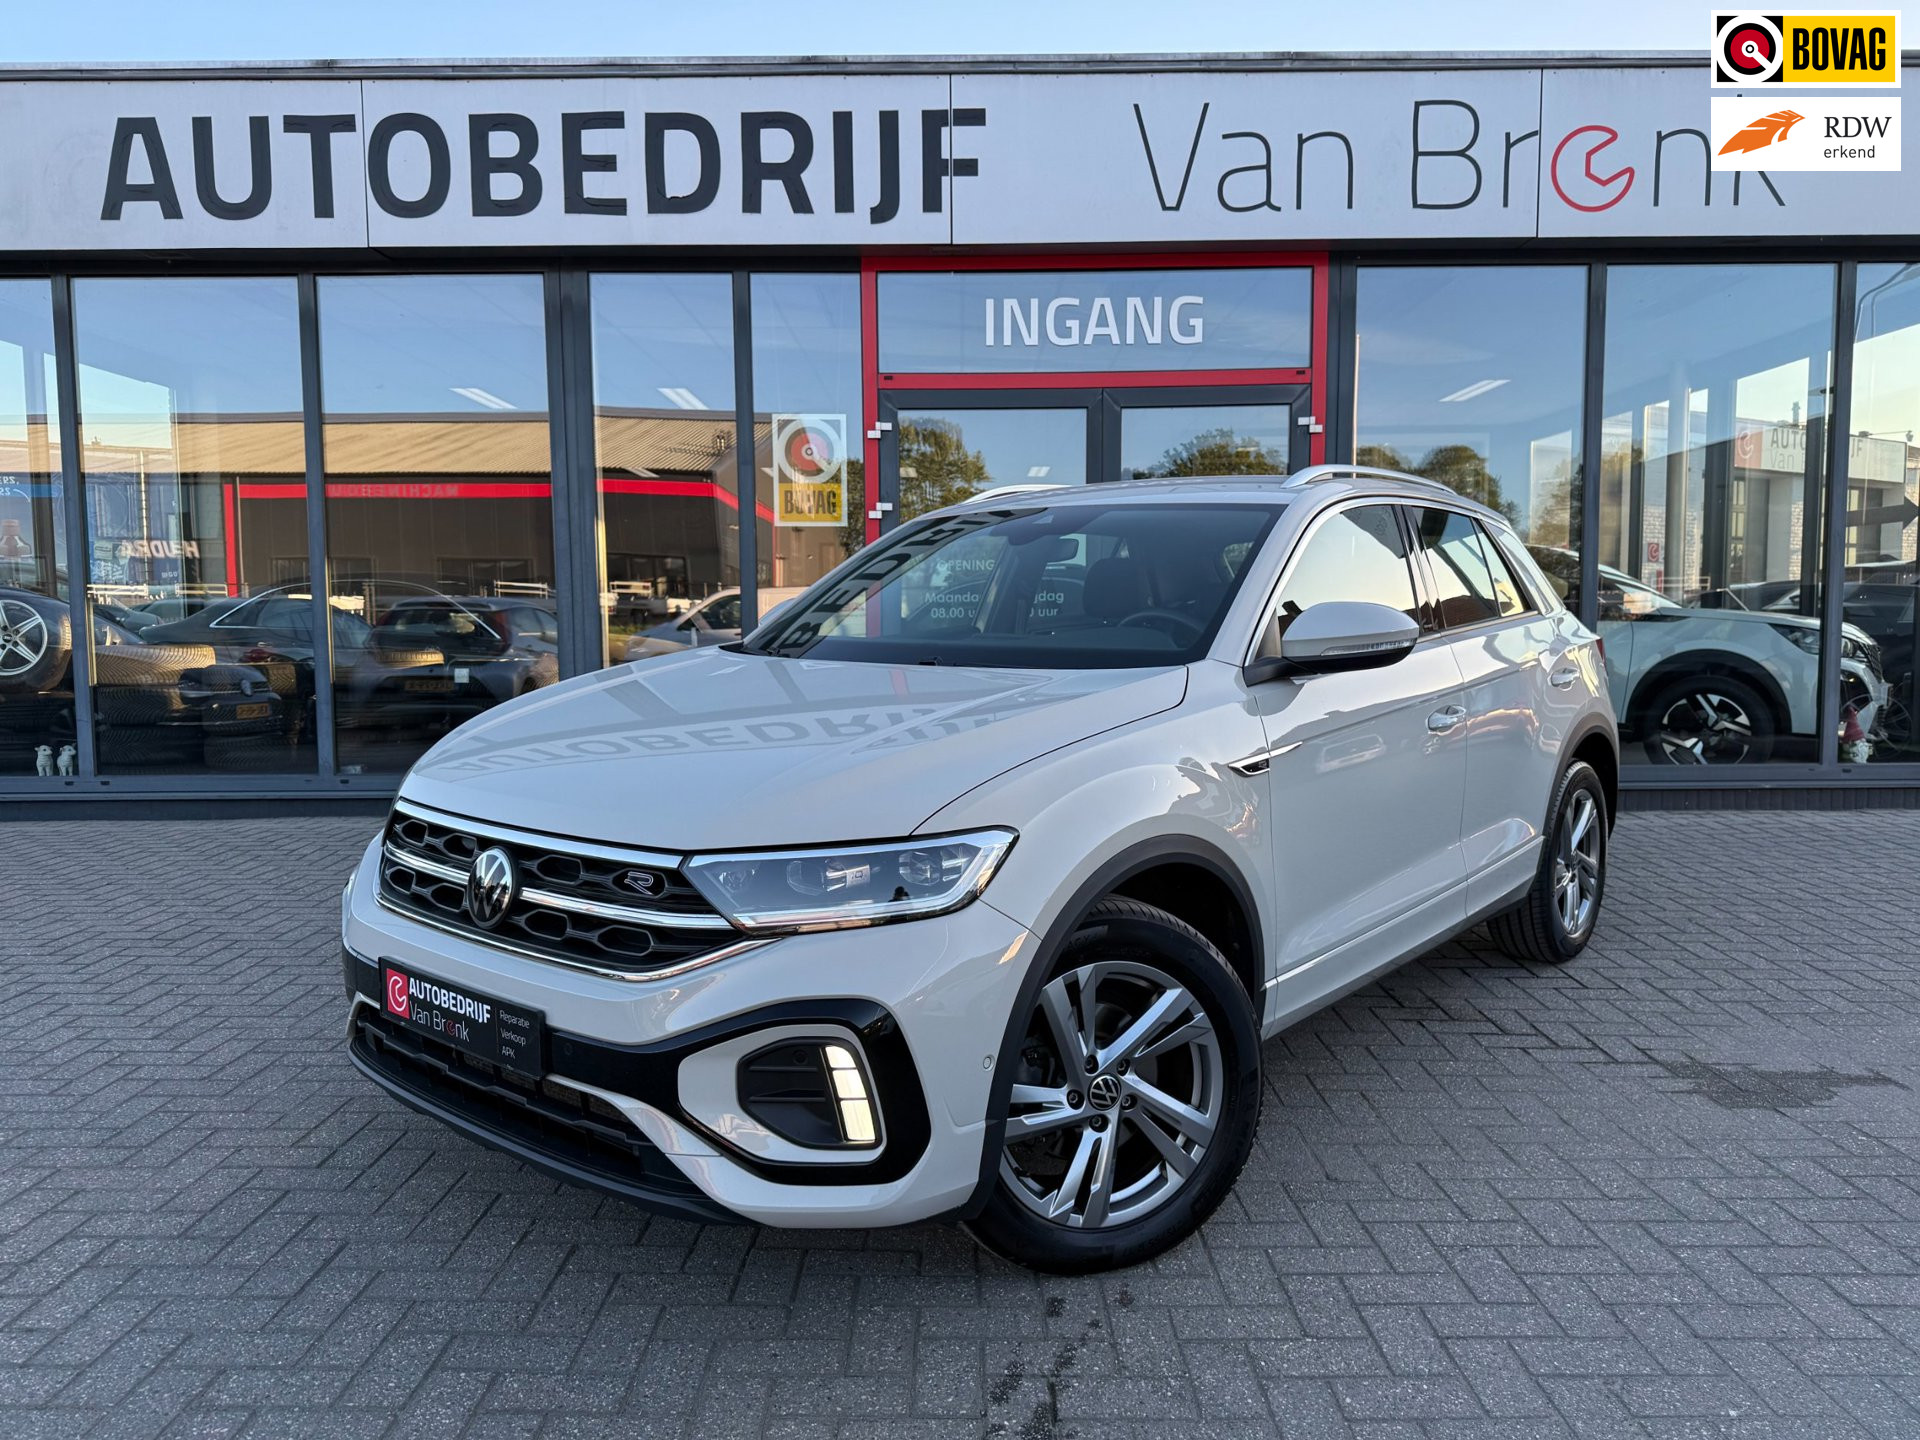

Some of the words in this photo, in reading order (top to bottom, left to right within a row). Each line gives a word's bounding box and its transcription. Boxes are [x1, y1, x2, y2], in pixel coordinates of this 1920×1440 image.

[101, 108, 986, 224] AUTOBEDRIJF
[1134, 102, 1354, 212] Van
[985, 295, 1204, 346] INGANG
[925, 592, 980, 604] Maanda
[931, 607, 965, 619] 08.00
[409, 977, 491, 1024] AUTOBEDRIJF
[410, 1001, 431, 1027] Van
[500, 1009, 530, 1029] Reparatie
[500, 1028, 527, 1047] Verkoop
[501, 1045, 516, 1060] APK
